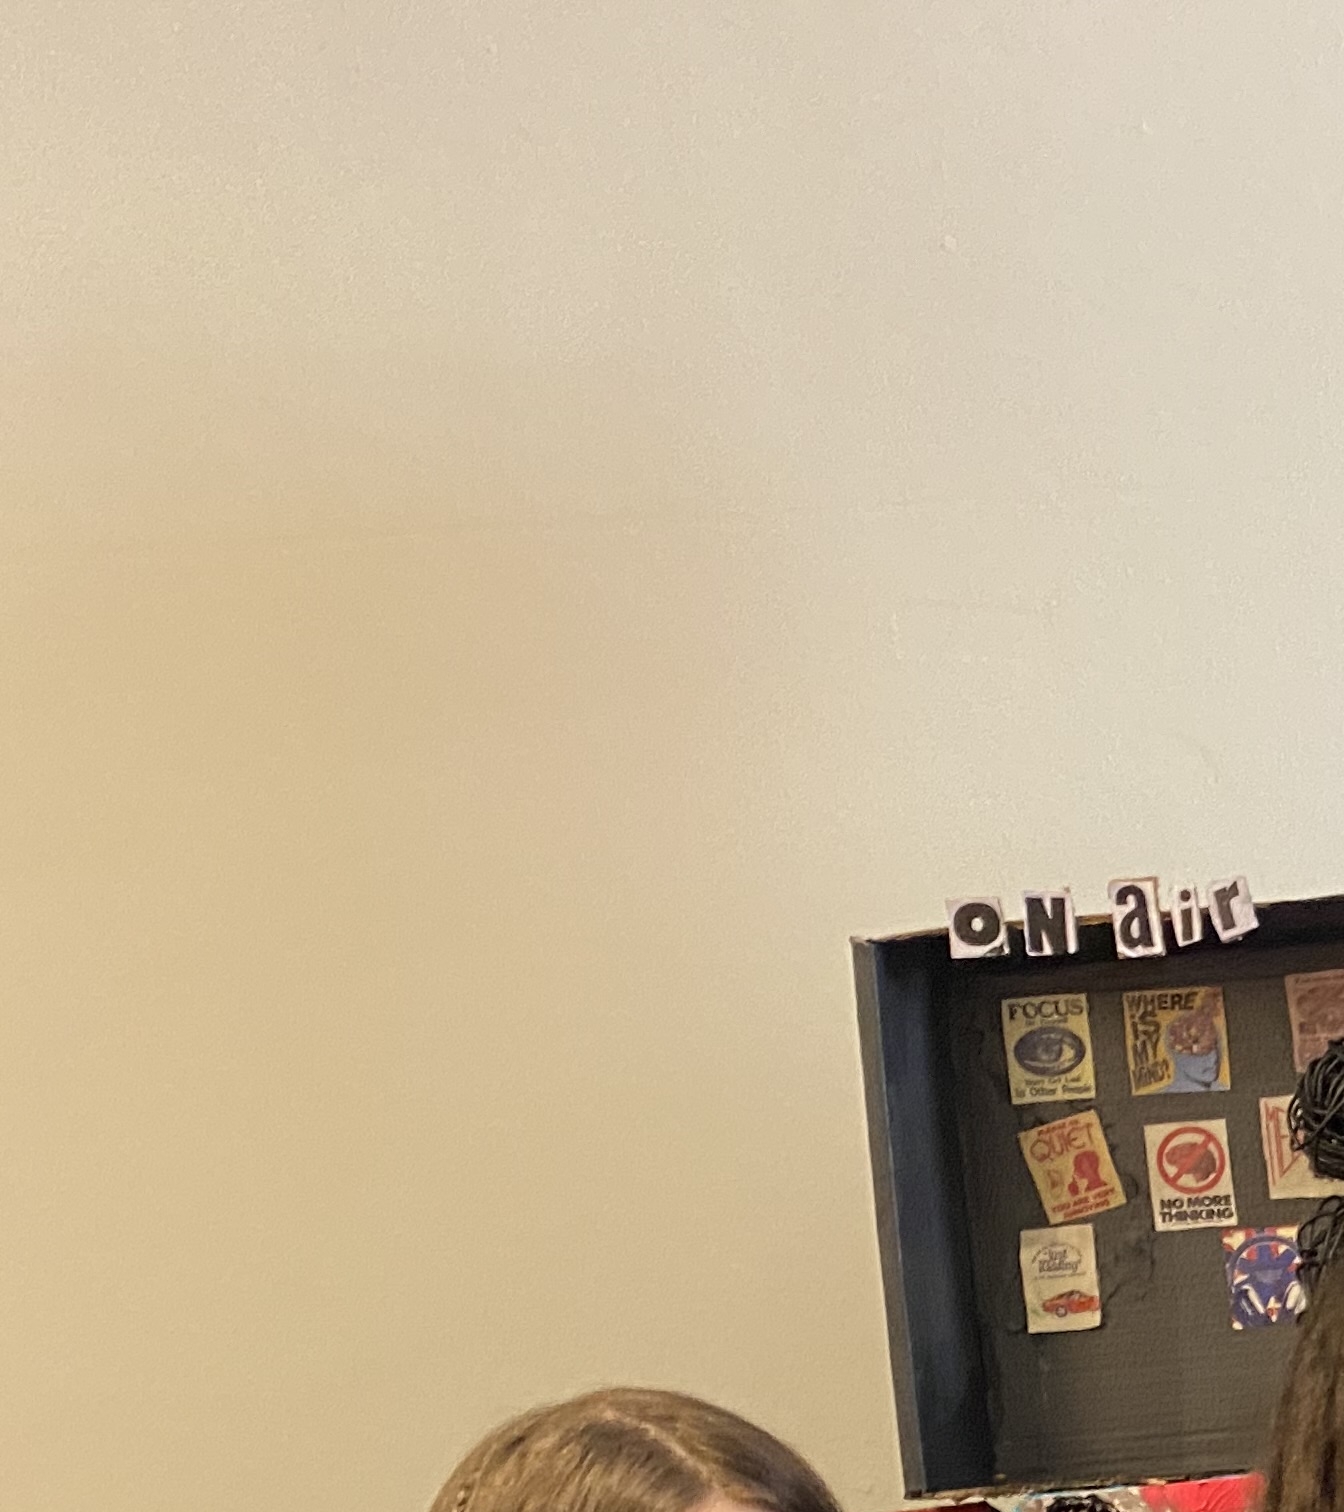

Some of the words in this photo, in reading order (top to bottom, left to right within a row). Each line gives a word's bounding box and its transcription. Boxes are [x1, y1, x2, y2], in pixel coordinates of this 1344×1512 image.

[1117, 881, 1241, 949] air
[1007, 998, 1085, 1022] FOCUS
[1125, 991, 1199, 1012] WHERE
[1029, 1122, 1097, 1163] QUIET
[1159, 1198, 1184, 1211] NO
[1186, 1195, 1232, 1208] MORE
[1160, 1207, 1234, 1223] THINKING
